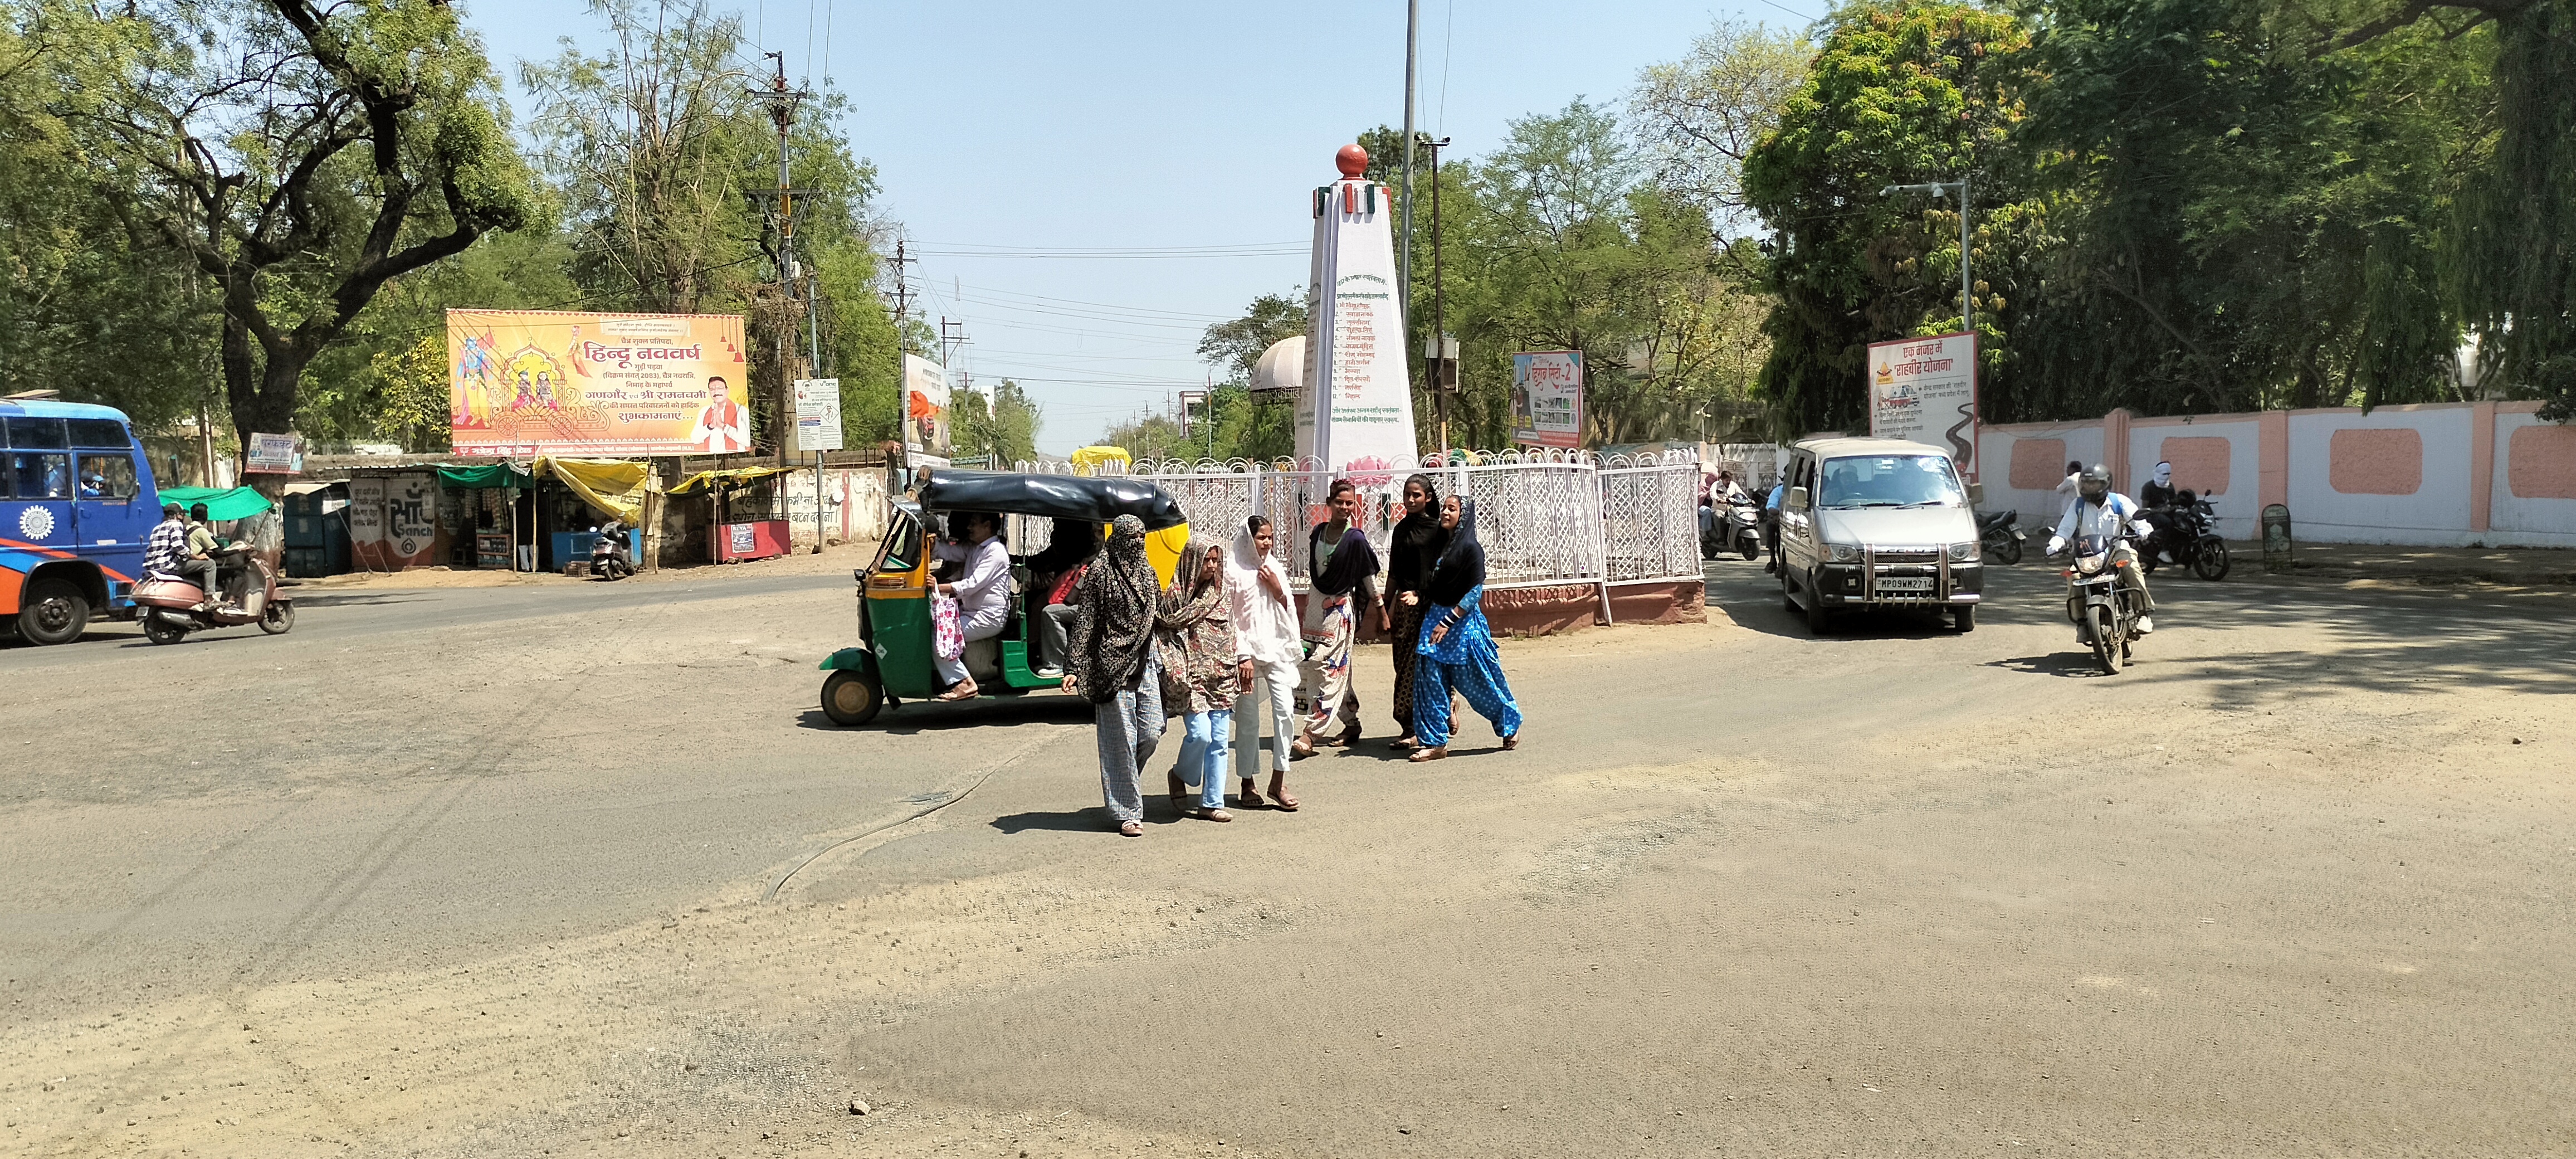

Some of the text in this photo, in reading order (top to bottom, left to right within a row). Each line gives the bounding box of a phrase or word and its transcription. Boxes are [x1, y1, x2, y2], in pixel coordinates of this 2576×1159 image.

[583, 341, 702, 368] हिन्दू नववर्ष
[1903, 340, 1943, 358] एक नजर में
[585, 388, 628, 400] गणगौर
[640, 390, 654, 399] श्री
[657, 390, 707, 400] रामनवमी
[792, 512, 809, 523] बटन
[1881, 580, 1933, 588] MP09WM2714
